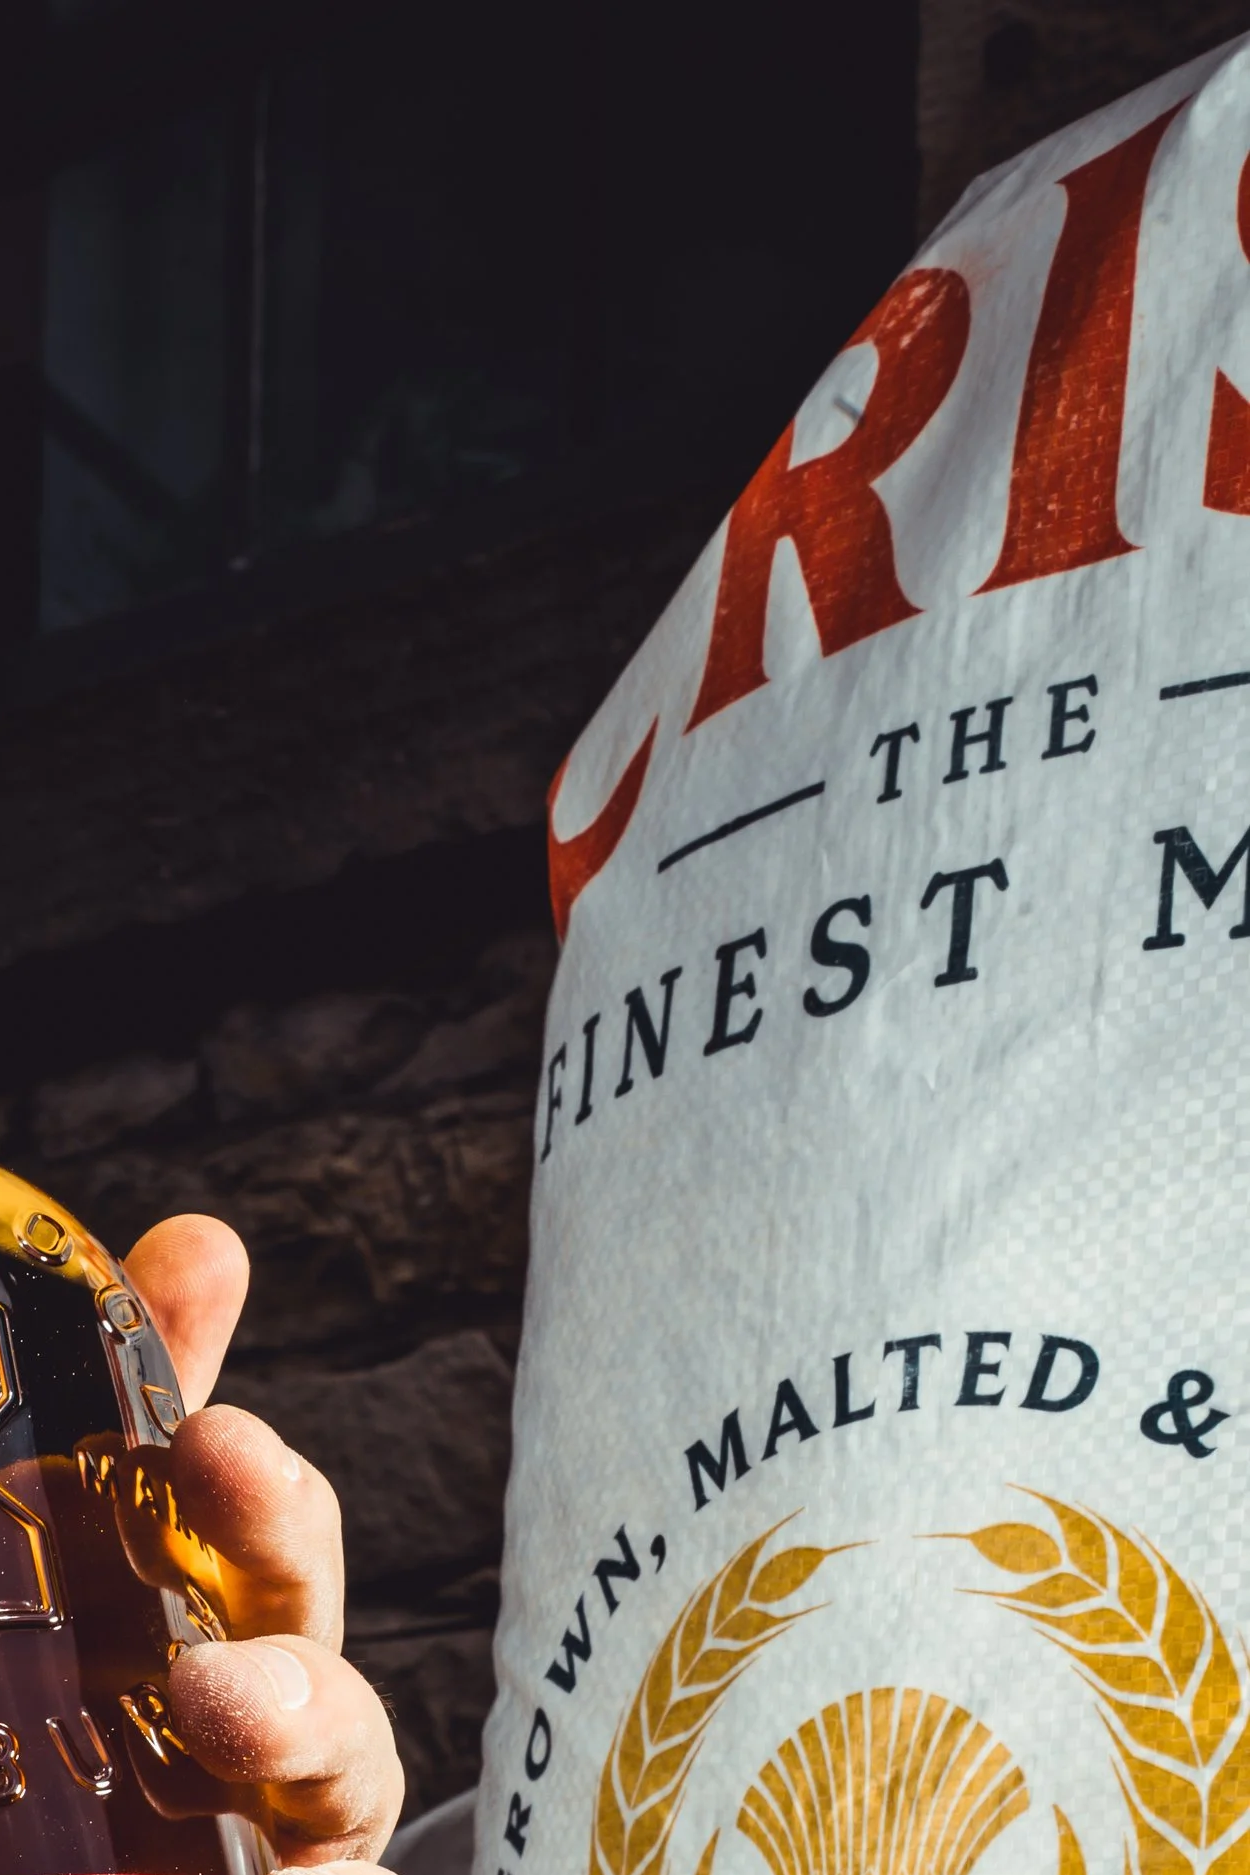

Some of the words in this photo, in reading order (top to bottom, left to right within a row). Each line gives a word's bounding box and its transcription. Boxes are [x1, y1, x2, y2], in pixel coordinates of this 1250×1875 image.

[870, 674, 1098, 803] THE
[540, 857, 1009, 1164] FINEST
[684, 1331, 1101, 1511] MALTED
[1139, 1369, 1230, 1458] &
